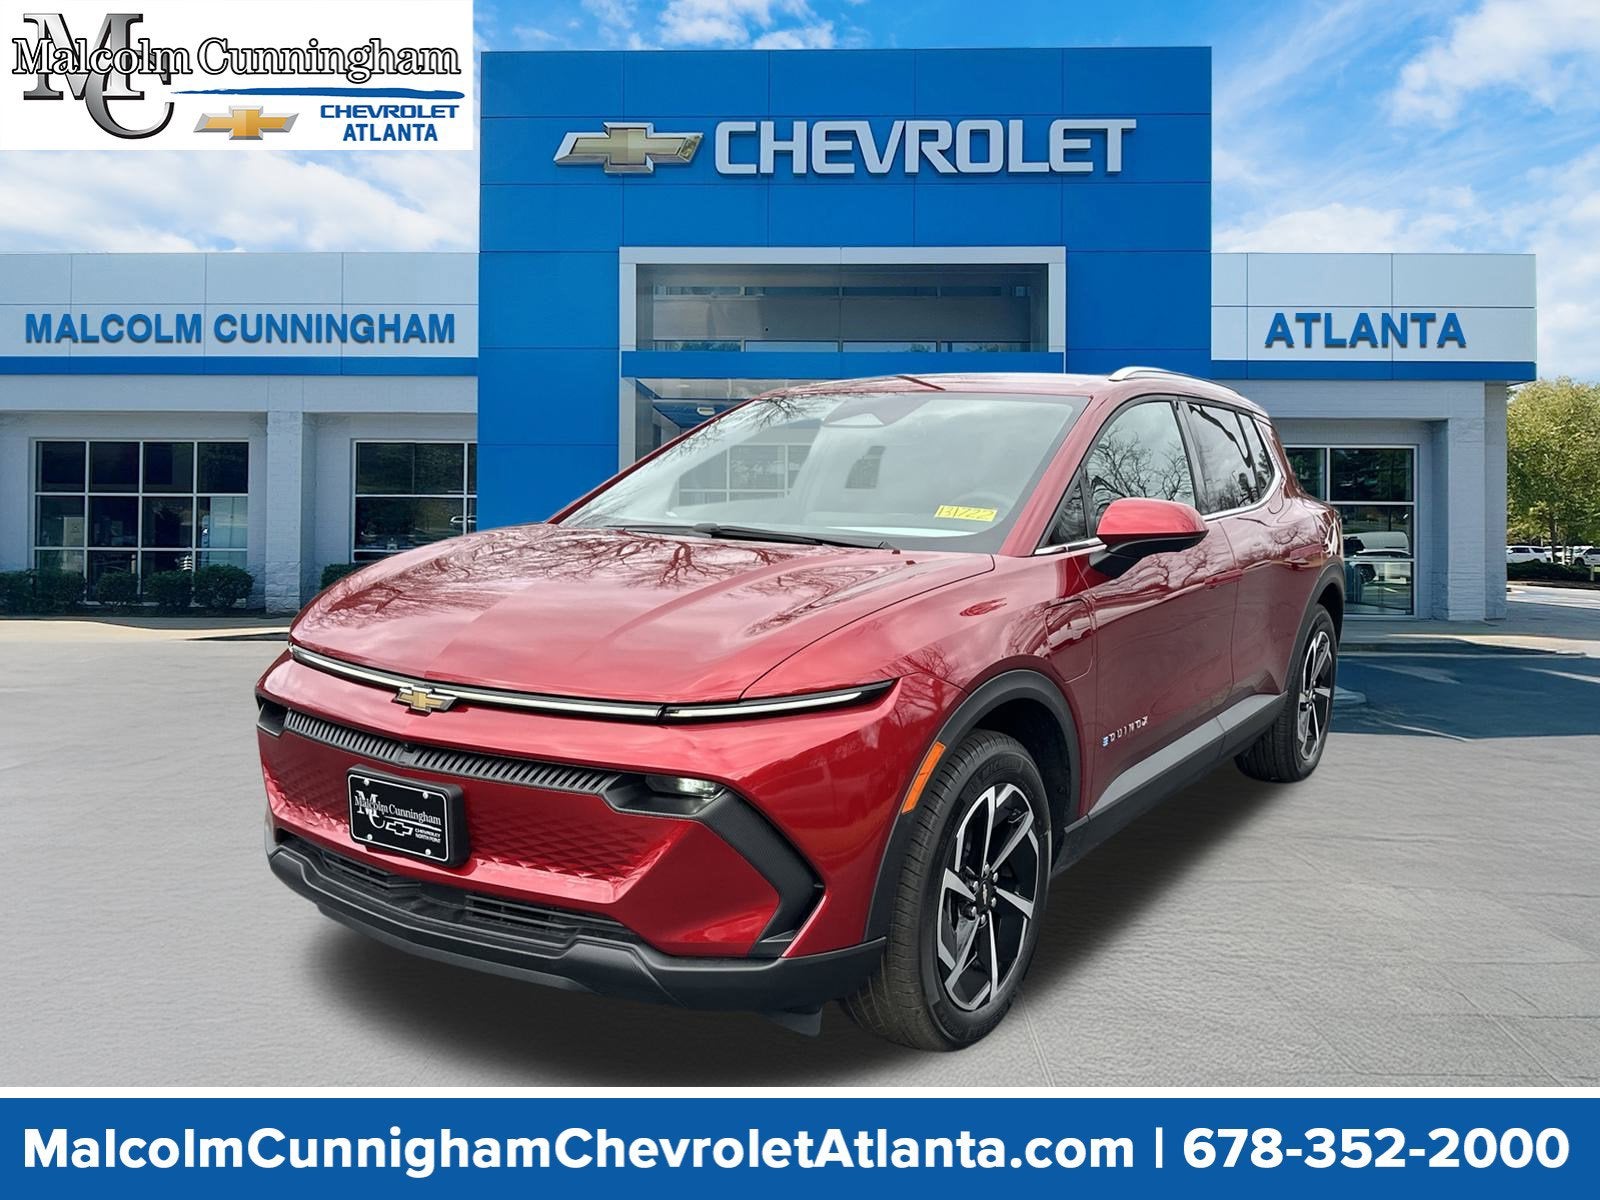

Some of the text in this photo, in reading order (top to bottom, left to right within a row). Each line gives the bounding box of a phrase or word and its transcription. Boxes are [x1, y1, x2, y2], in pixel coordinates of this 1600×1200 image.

[715, 119, 1137, 175] CHEVROLET
[25, 313, 456, 344] MALCOLM CUNNINGHAM
[1264, 312, 1467, 349] ATLANTA
[389, 804, 442, 826] Cunningham
